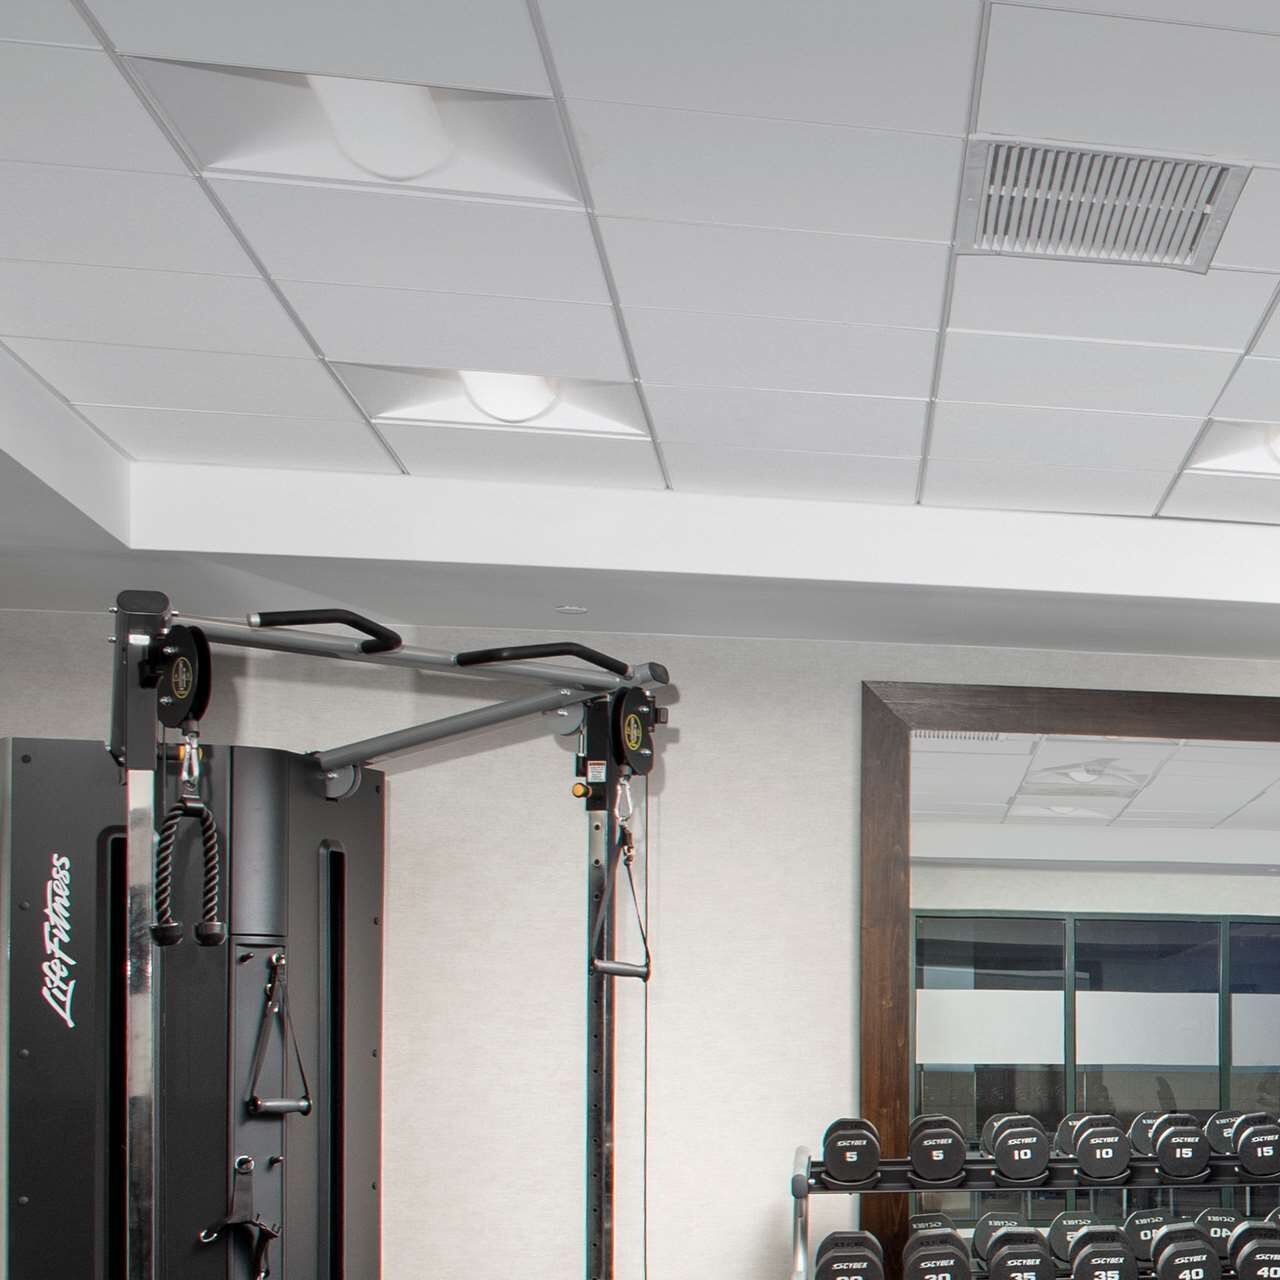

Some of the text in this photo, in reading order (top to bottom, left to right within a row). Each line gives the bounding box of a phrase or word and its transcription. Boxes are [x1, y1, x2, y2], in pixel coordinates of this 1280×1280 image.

[846, 1152, 857, 1161] 5
[932, 1150, 943, 1160] 5
[1014, 1149, 1031, 1160] 10
[1096, 1149, 1112, 1158] 10
[1176, 1148, 1192, 1157] 15
[1257, 1147, 1273, 1157] 15
[931, 1260, 955, 1268] CYBEX
[1017, 1258, 1041, 1266] CYBEX
[1184, 1254, 1208, 1264] CYBEX
[1179, 1269, 1203, 1280] 40
[1257, 1267, 1280, 1278] 40
